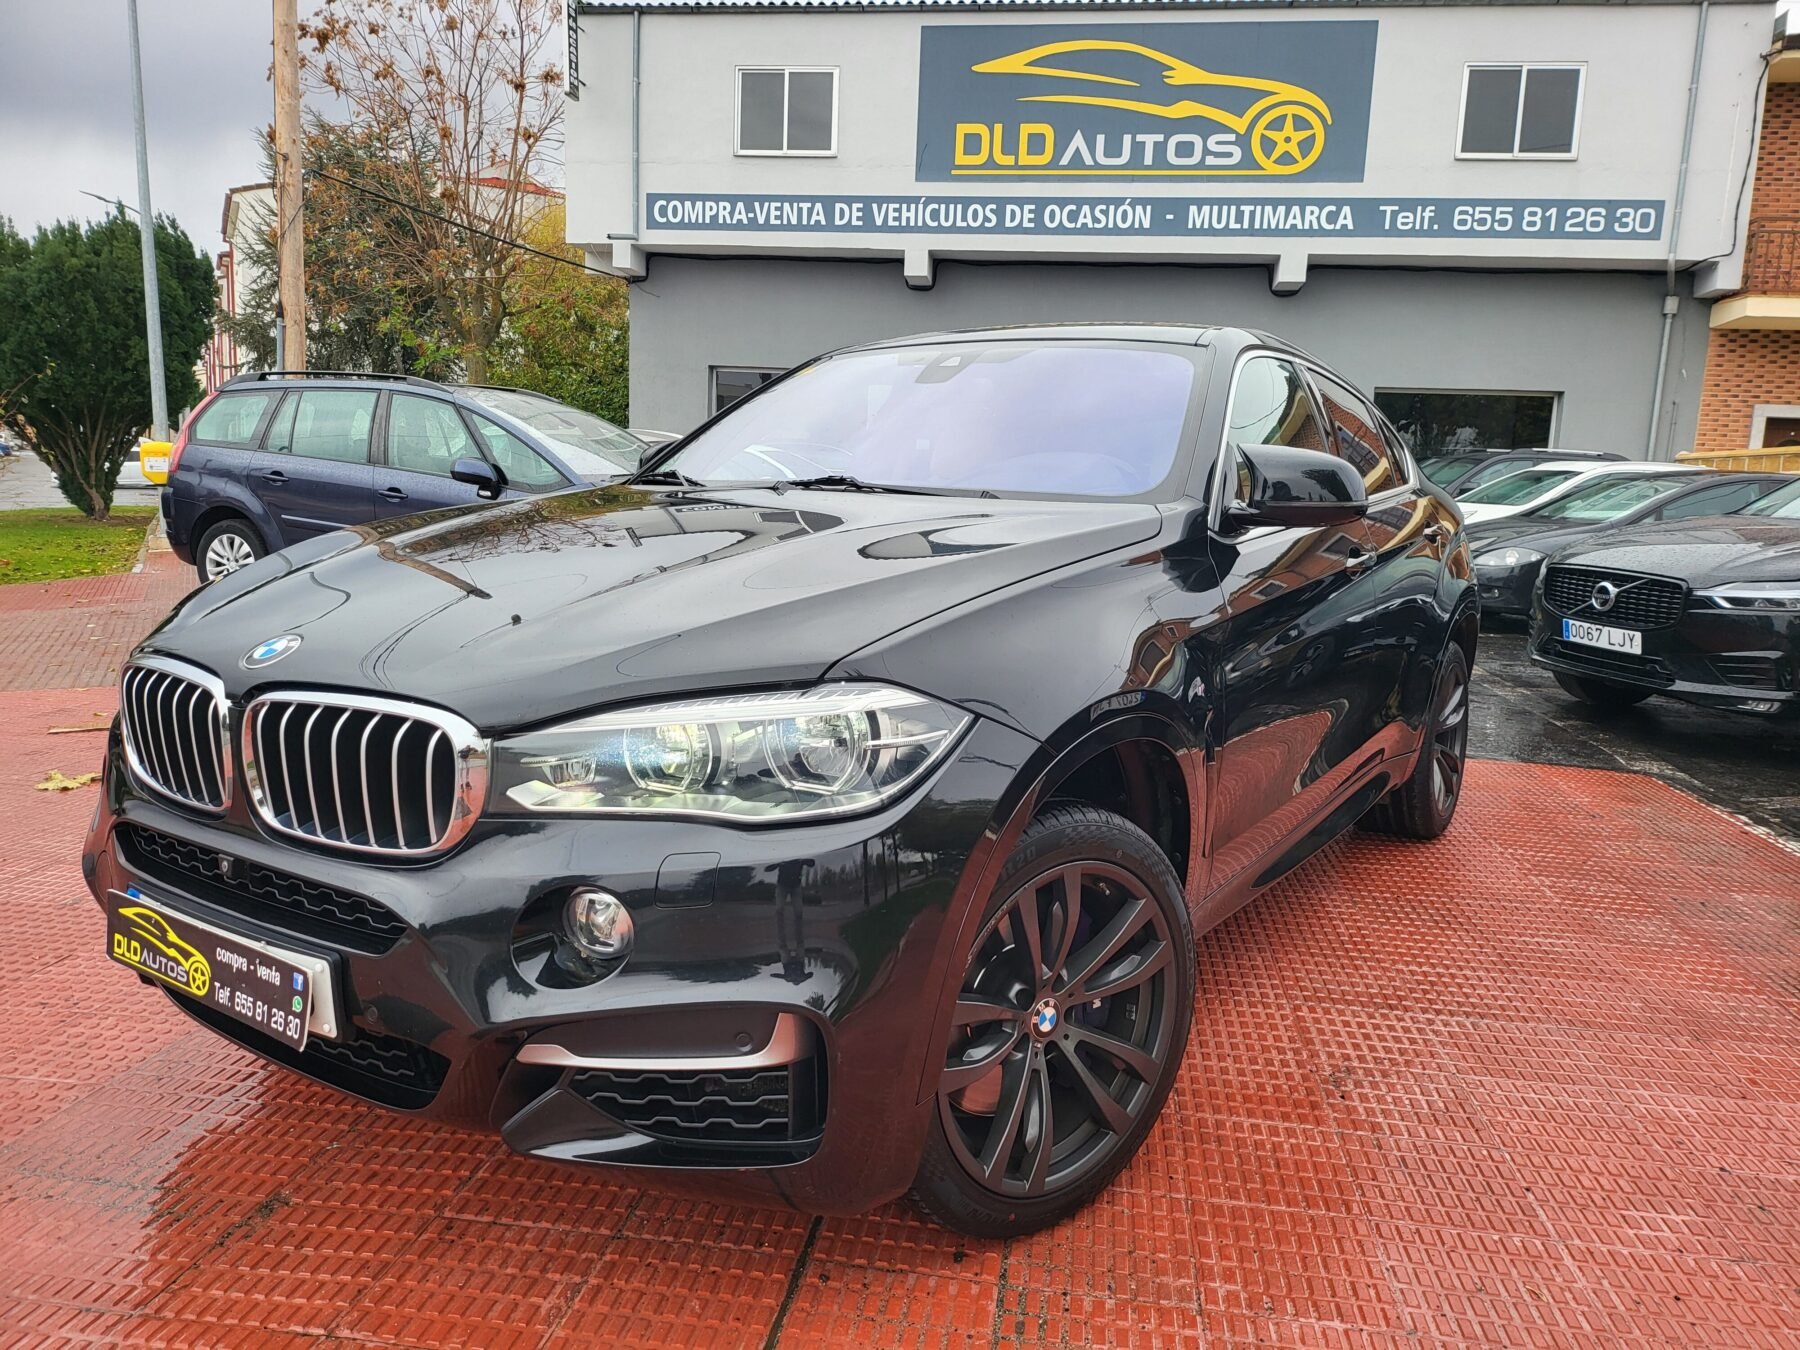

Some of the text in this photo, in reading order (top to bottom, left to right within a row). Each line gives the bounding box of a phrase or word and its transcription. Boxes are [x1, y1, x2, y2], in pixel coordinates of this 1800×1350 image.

[955, 123, 1242, 166] DLD AUTOS
[653, 199, 826, 226] COMPRA-VENTA
[835, 202, 864, 227] DE
[872, 198, 997, 228] VEHÍCULOS
[1005, 203, 1036, 228] DE
[1044, 198, 1152, 229] OCASIÓN
[1187, 205, 1354, 230] MULTIMARCA
[1380, 205, 1439, 231] Telf.
[1453, 206, 1513, 232] 655
[1522, 207, 1557, 232] 81
[1564, 207, 1606, 232] 26
[1614, 208, 1656, 233] 30
[1570, 623, 1636, 649] 0067 LJY
[114, 933, 188, 982] DLD AUTOS
[216, 947, 247, 973] compra
[256, 961, 280, 986] venta
[214, 982, 301, 1039] Telf. 655 81 26 30
